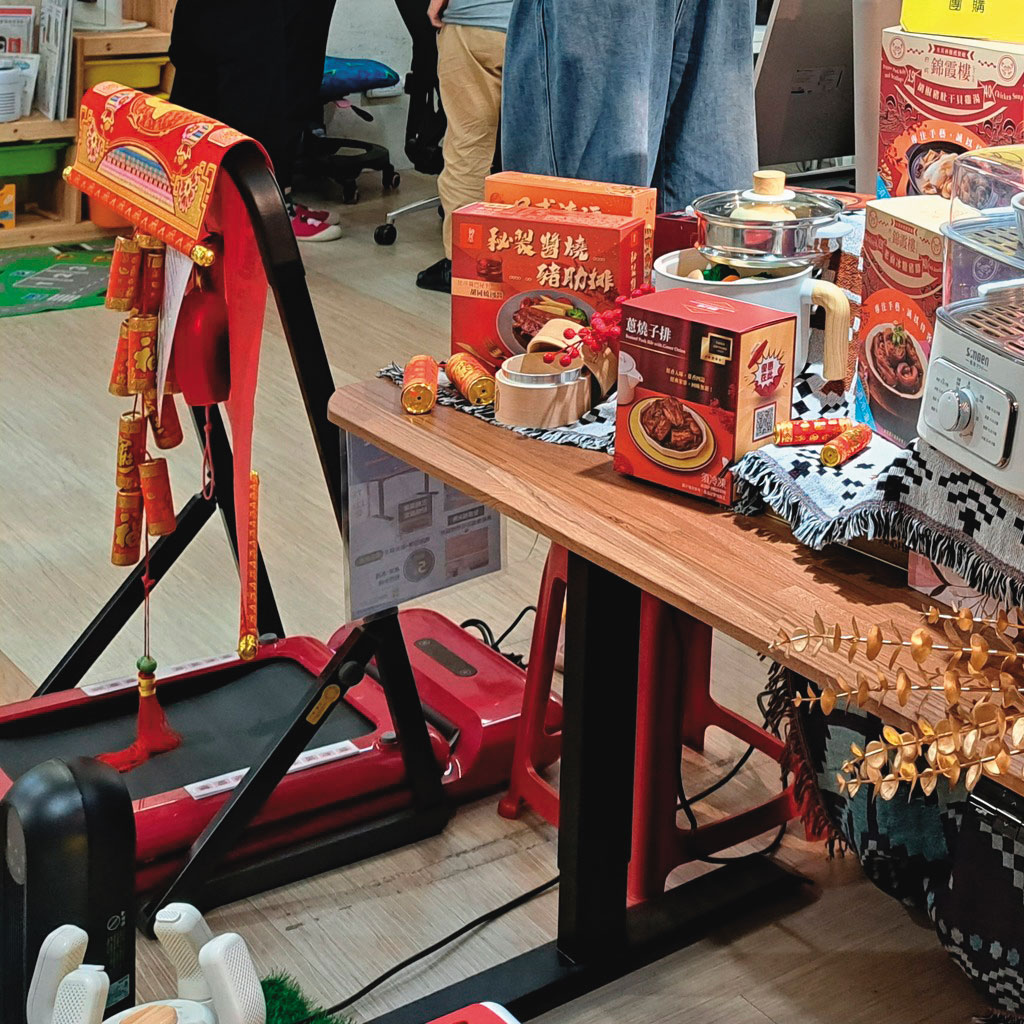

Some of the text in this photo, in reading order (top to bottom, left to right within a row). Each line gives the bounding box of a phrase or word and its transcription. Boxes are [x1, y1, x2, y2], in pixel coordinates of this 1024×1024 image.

[931, 57, 972, 82] 錦霞樓
[487, 226, 589, 262] 秘製醬燒
[536, 263, 616, 292] 豬肋排
[625, 317, 672, 342] 蔥燒子排
